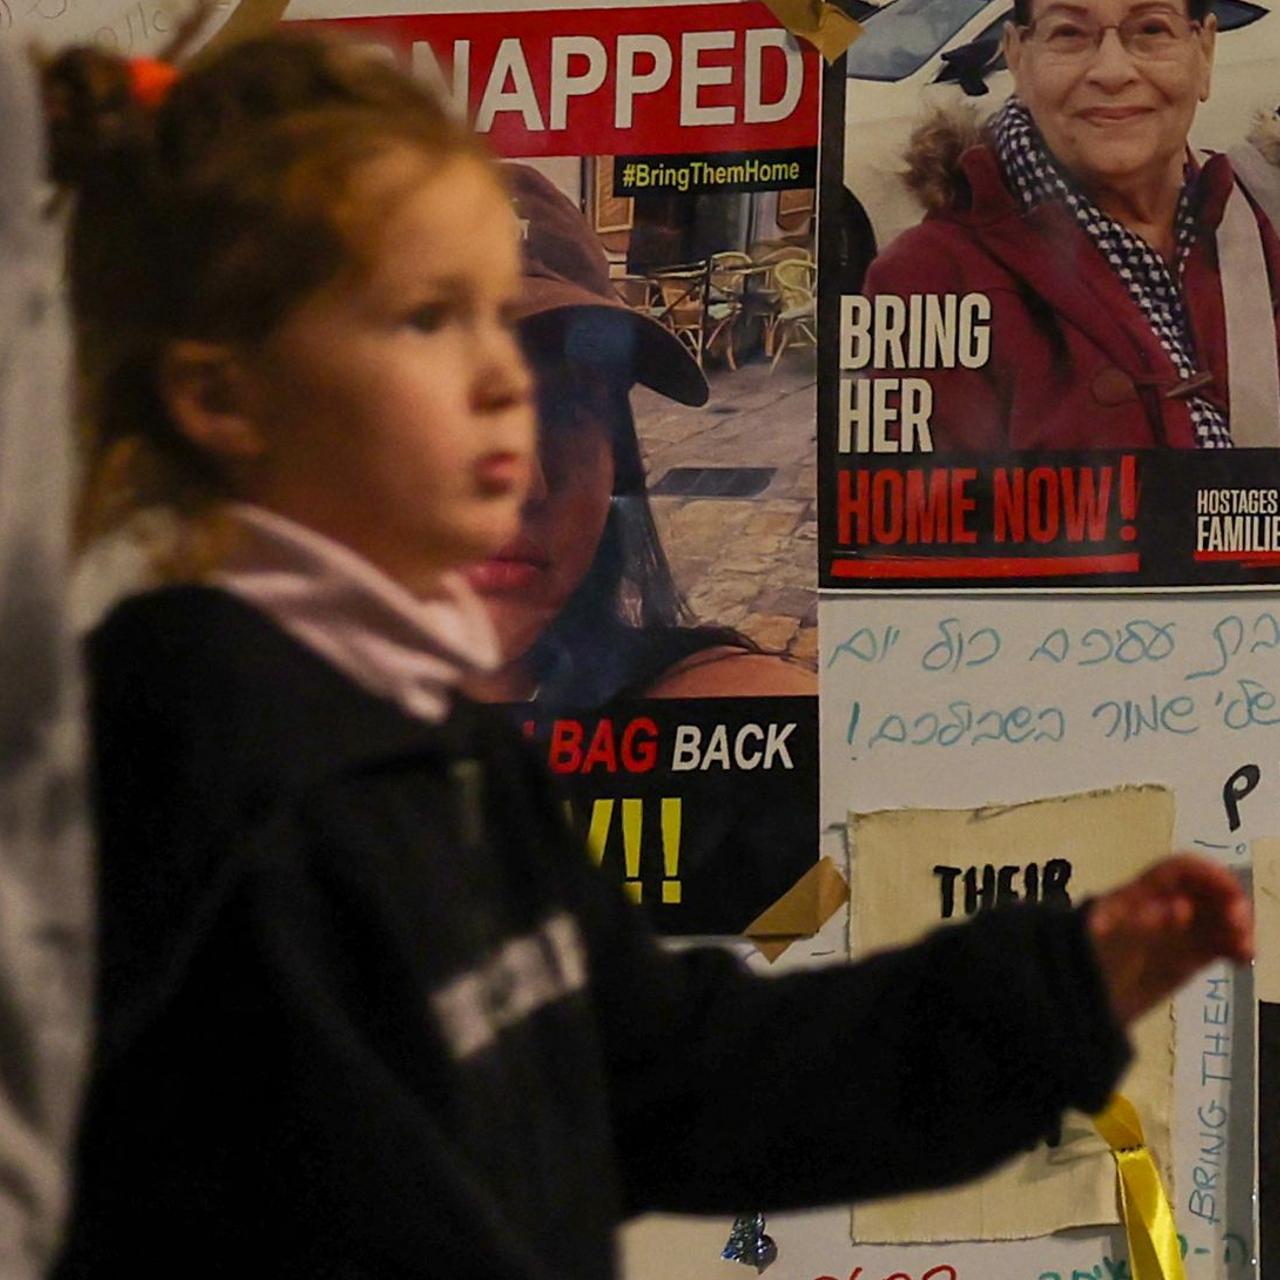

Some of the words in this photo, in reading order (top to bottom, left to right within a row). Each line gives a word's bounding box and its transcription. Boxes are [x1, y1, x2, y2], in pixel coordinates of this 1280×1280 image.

[410, 28, 803, 133] NAPPED
[622, 160, 799, 188] #BringThemHome
[840, 294, 989, 369] BRING
[839, 379, 932, 452] HER
[839, 469, 976, 544] HOME
[994, 456, 1136, 543] NOW!
[1198, 490, 1277, 513] HOSTAGES
[550, 717, 660, 774] BAG
[671, 723, 797, 771] BACK
[933, 858, 1073, 918] THEIR
